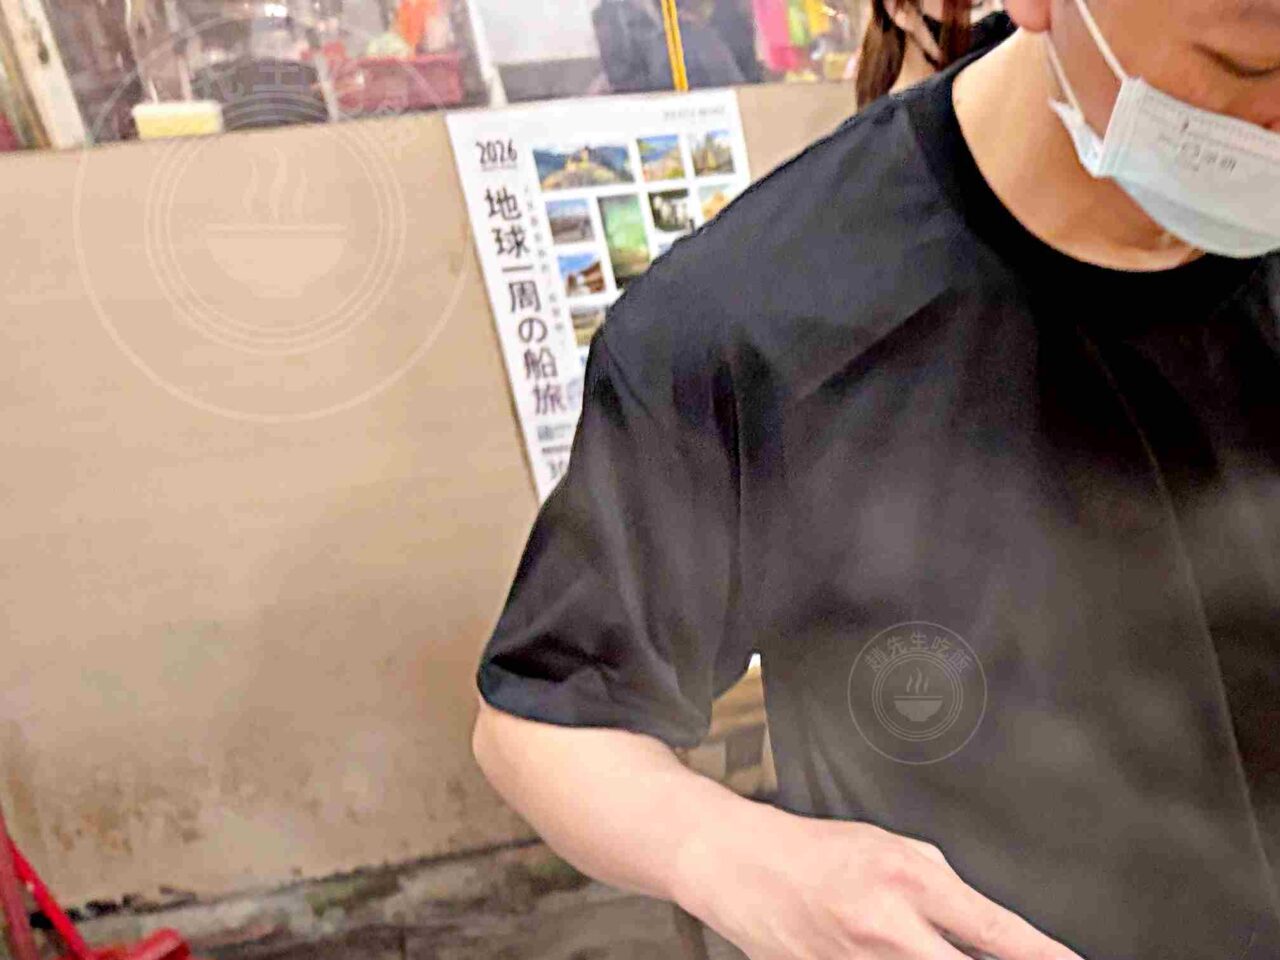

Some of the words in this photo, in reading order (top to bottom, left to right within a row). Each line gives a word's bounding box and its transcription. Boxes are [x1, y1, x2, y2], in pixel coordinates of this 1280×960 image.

[475, 138, 518, 164] 2026
[485, 187, 566, 415] 地球一周の船旅
